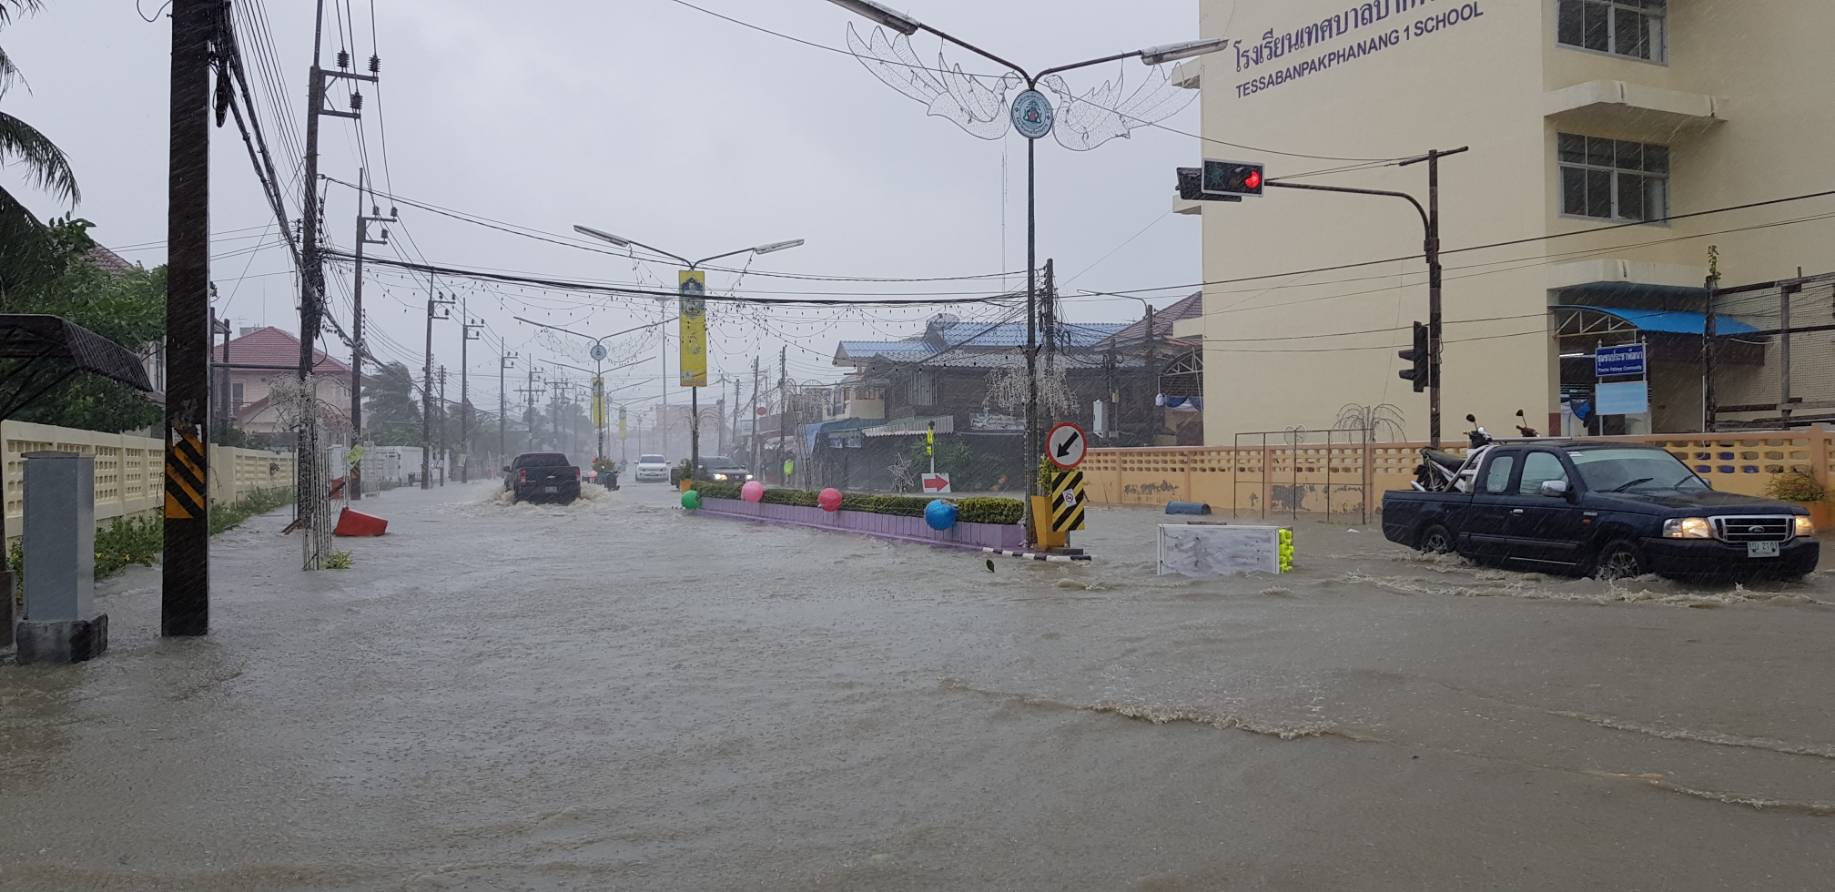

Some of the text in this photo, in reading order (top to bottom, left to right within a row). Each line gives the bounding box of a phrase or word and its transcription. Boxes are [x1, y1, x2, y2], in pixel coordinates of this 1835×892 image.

[1236, 1, 1484, 98] TESSABANPAKPHANANG 1 SCHOOL
